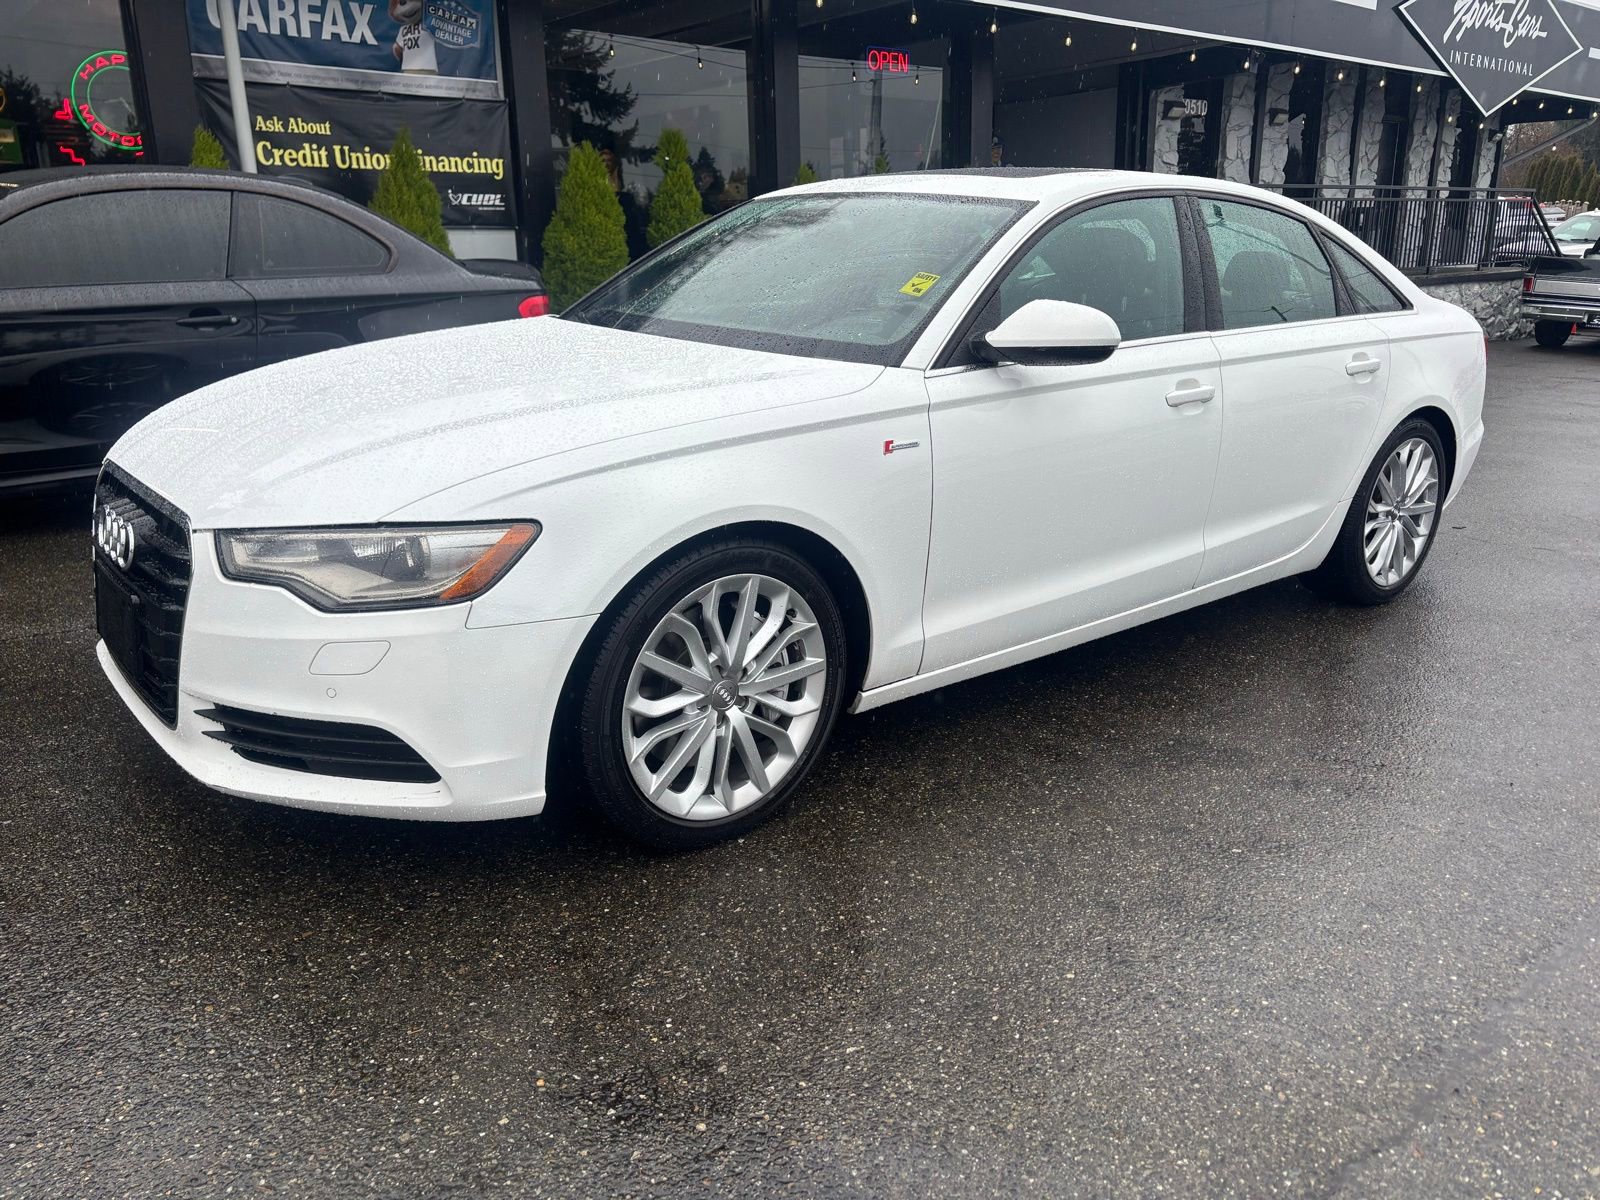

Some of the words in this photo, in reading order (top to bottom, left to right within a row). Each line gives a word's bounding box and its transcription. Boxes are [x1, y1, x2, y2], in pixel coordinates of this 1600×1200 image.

[428, 5, 475, 29] CARFAX
[401, 24, 420, 37] CAR
[430, 18, 472, 38] ADVANTAGE
[435, 29, 464, 45] DEALER
[403, 36, 420, 50] FOX
[80, 54, 125, 80] HAP
[868, 50, 908, 73] OPEN
[1450, 50, 1533, 76] INTERNATIONAL
[255, 115, 285, 132] Ask
[287, 117, 331, 135] About
[256, 140, 329, 168] Credit
[413, 148, 504, 180] inancing
